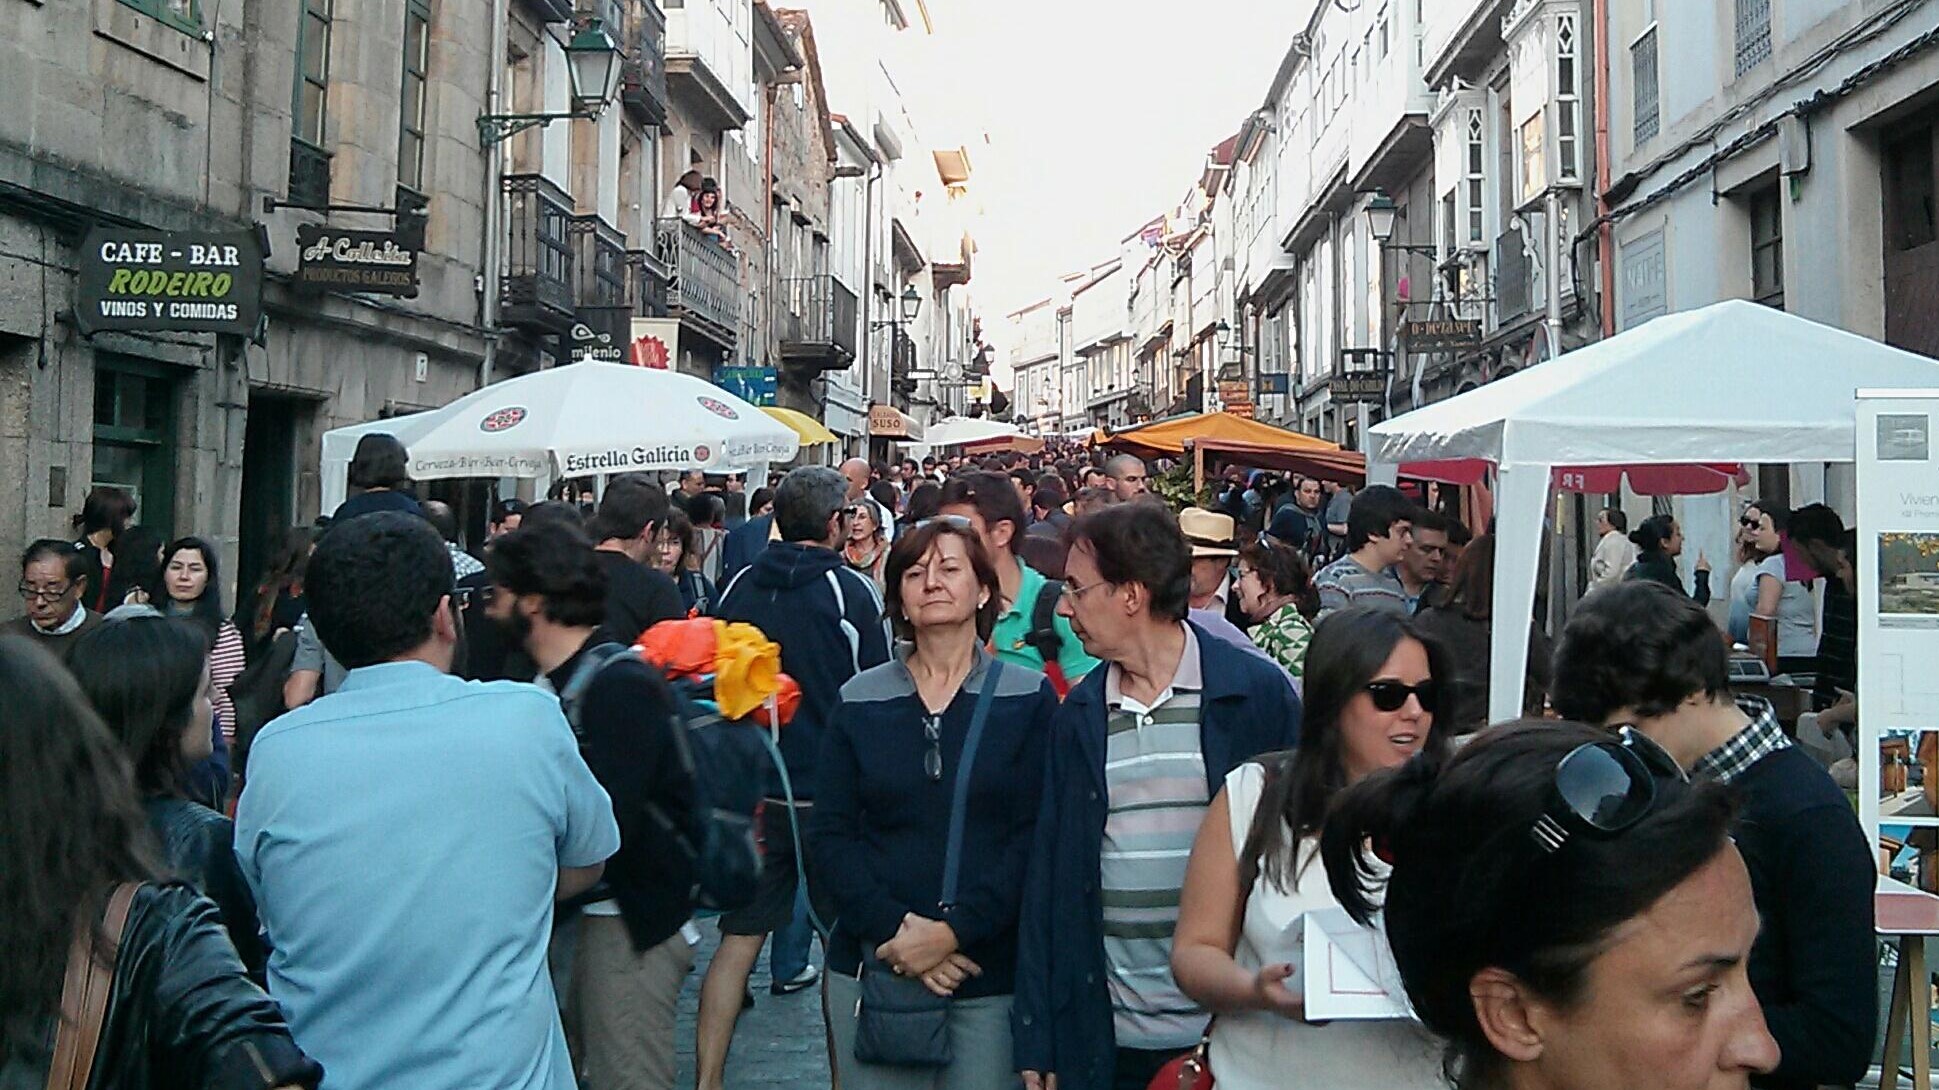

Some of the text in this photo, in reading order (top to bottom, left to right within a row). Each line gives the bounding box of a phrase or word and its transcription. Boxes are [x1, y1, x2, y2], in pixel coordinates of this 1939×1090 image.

[101, 242, 163, 264] CAFE
[190, 245, 240, 266] BAR
[303, 237, 412, 265] A Colleita
[108, 268, 233, 298] RODEIRO
[100, 301, 238, 320] VINOS Y COMIDAS
[571, 345, 621, 358] milenio
[873, 419, 900, 428] SUSO
[566, 446, 690, 472] Estrella Galicia
